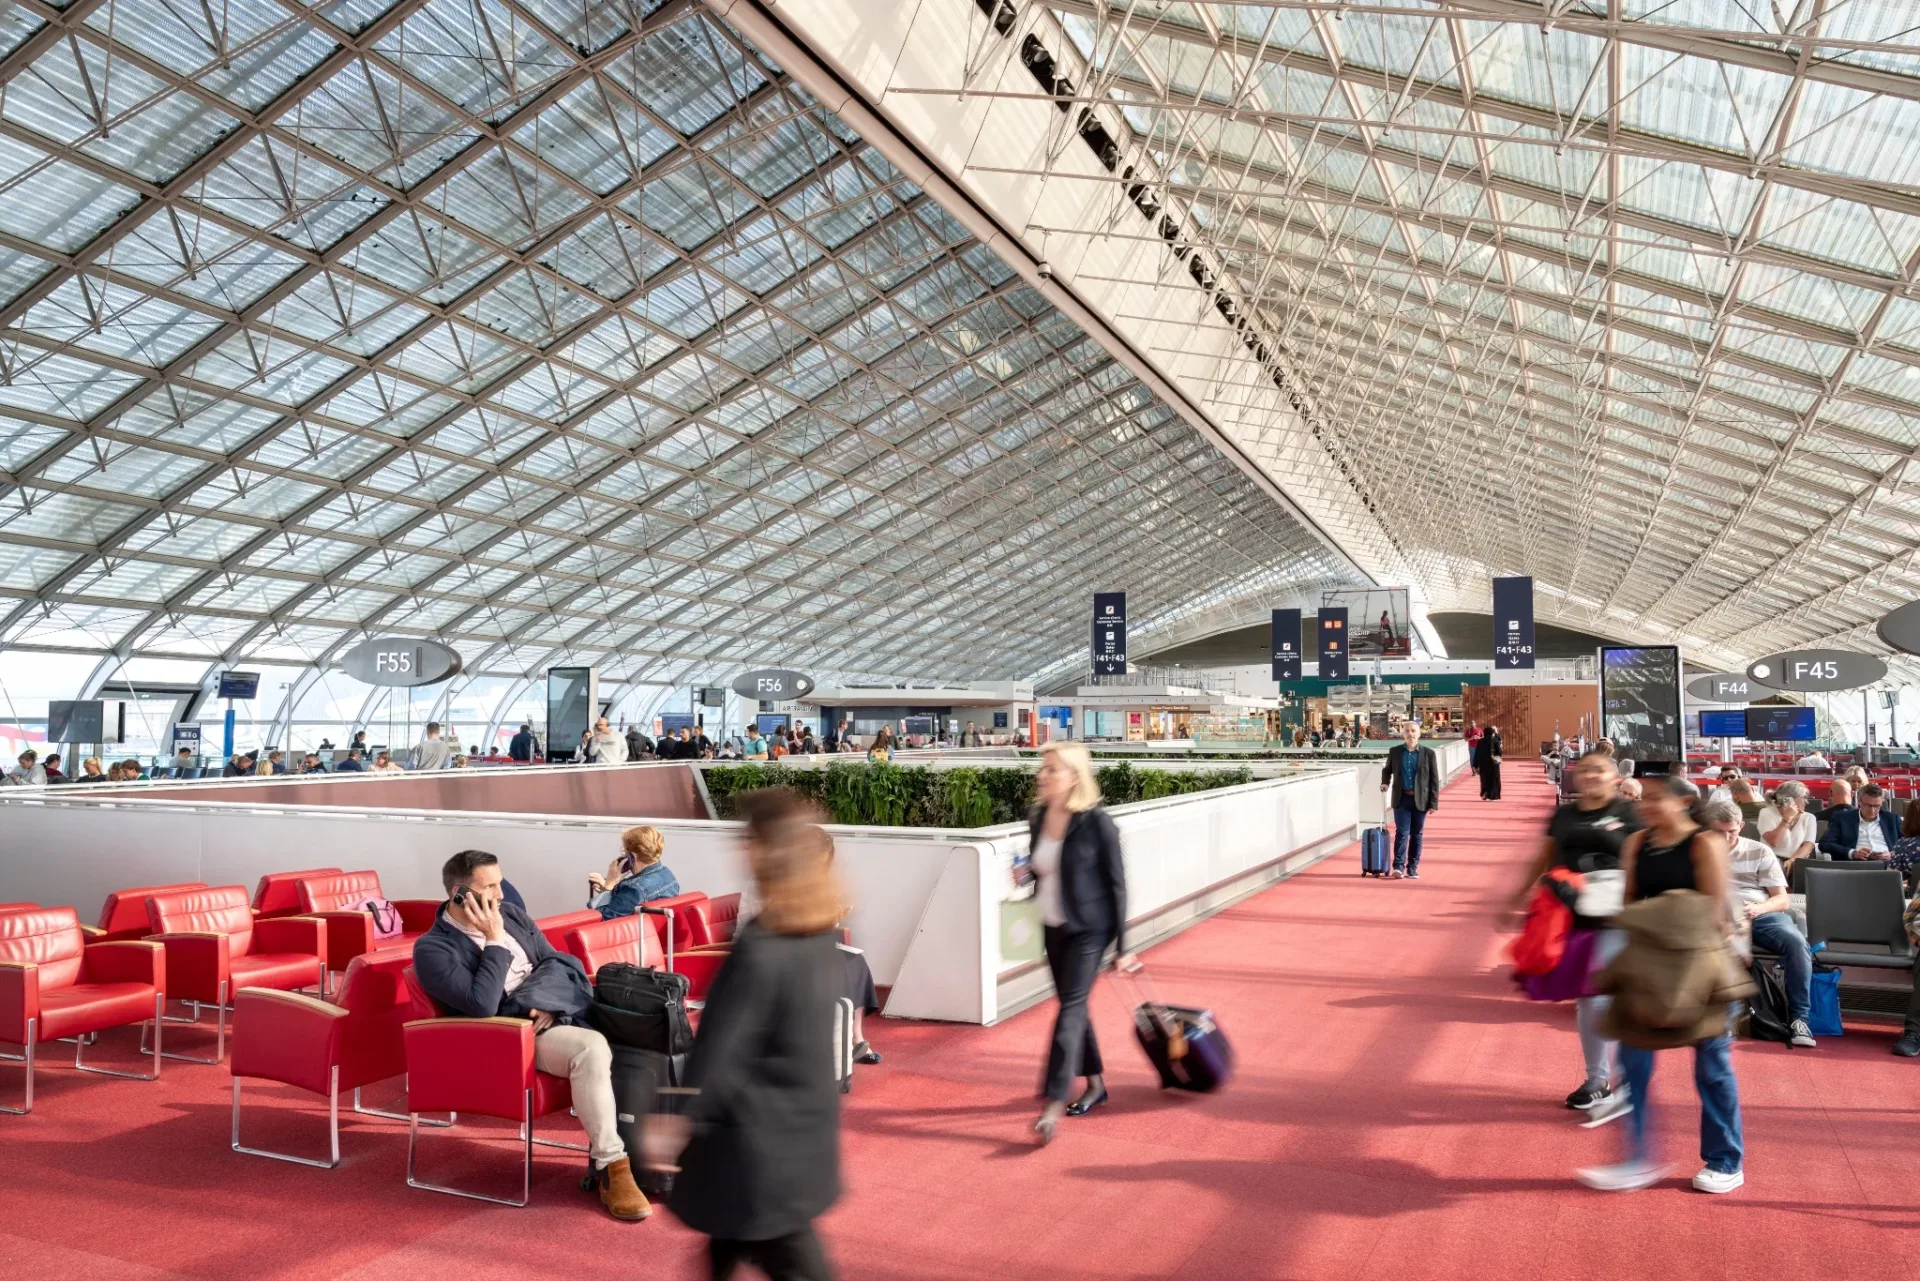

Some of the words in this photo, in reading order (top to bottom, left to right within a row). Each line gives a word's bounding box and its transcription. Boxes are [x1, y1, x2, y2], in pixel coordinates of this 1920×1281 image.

[1496, 646, 1532, 654] F41-F43
[377, 652, 411, 673] F55
[1795, 661, 1838, 680] F45
[757, 678, 782, 691] F56
[1719, 682, 1748, 695] F44
